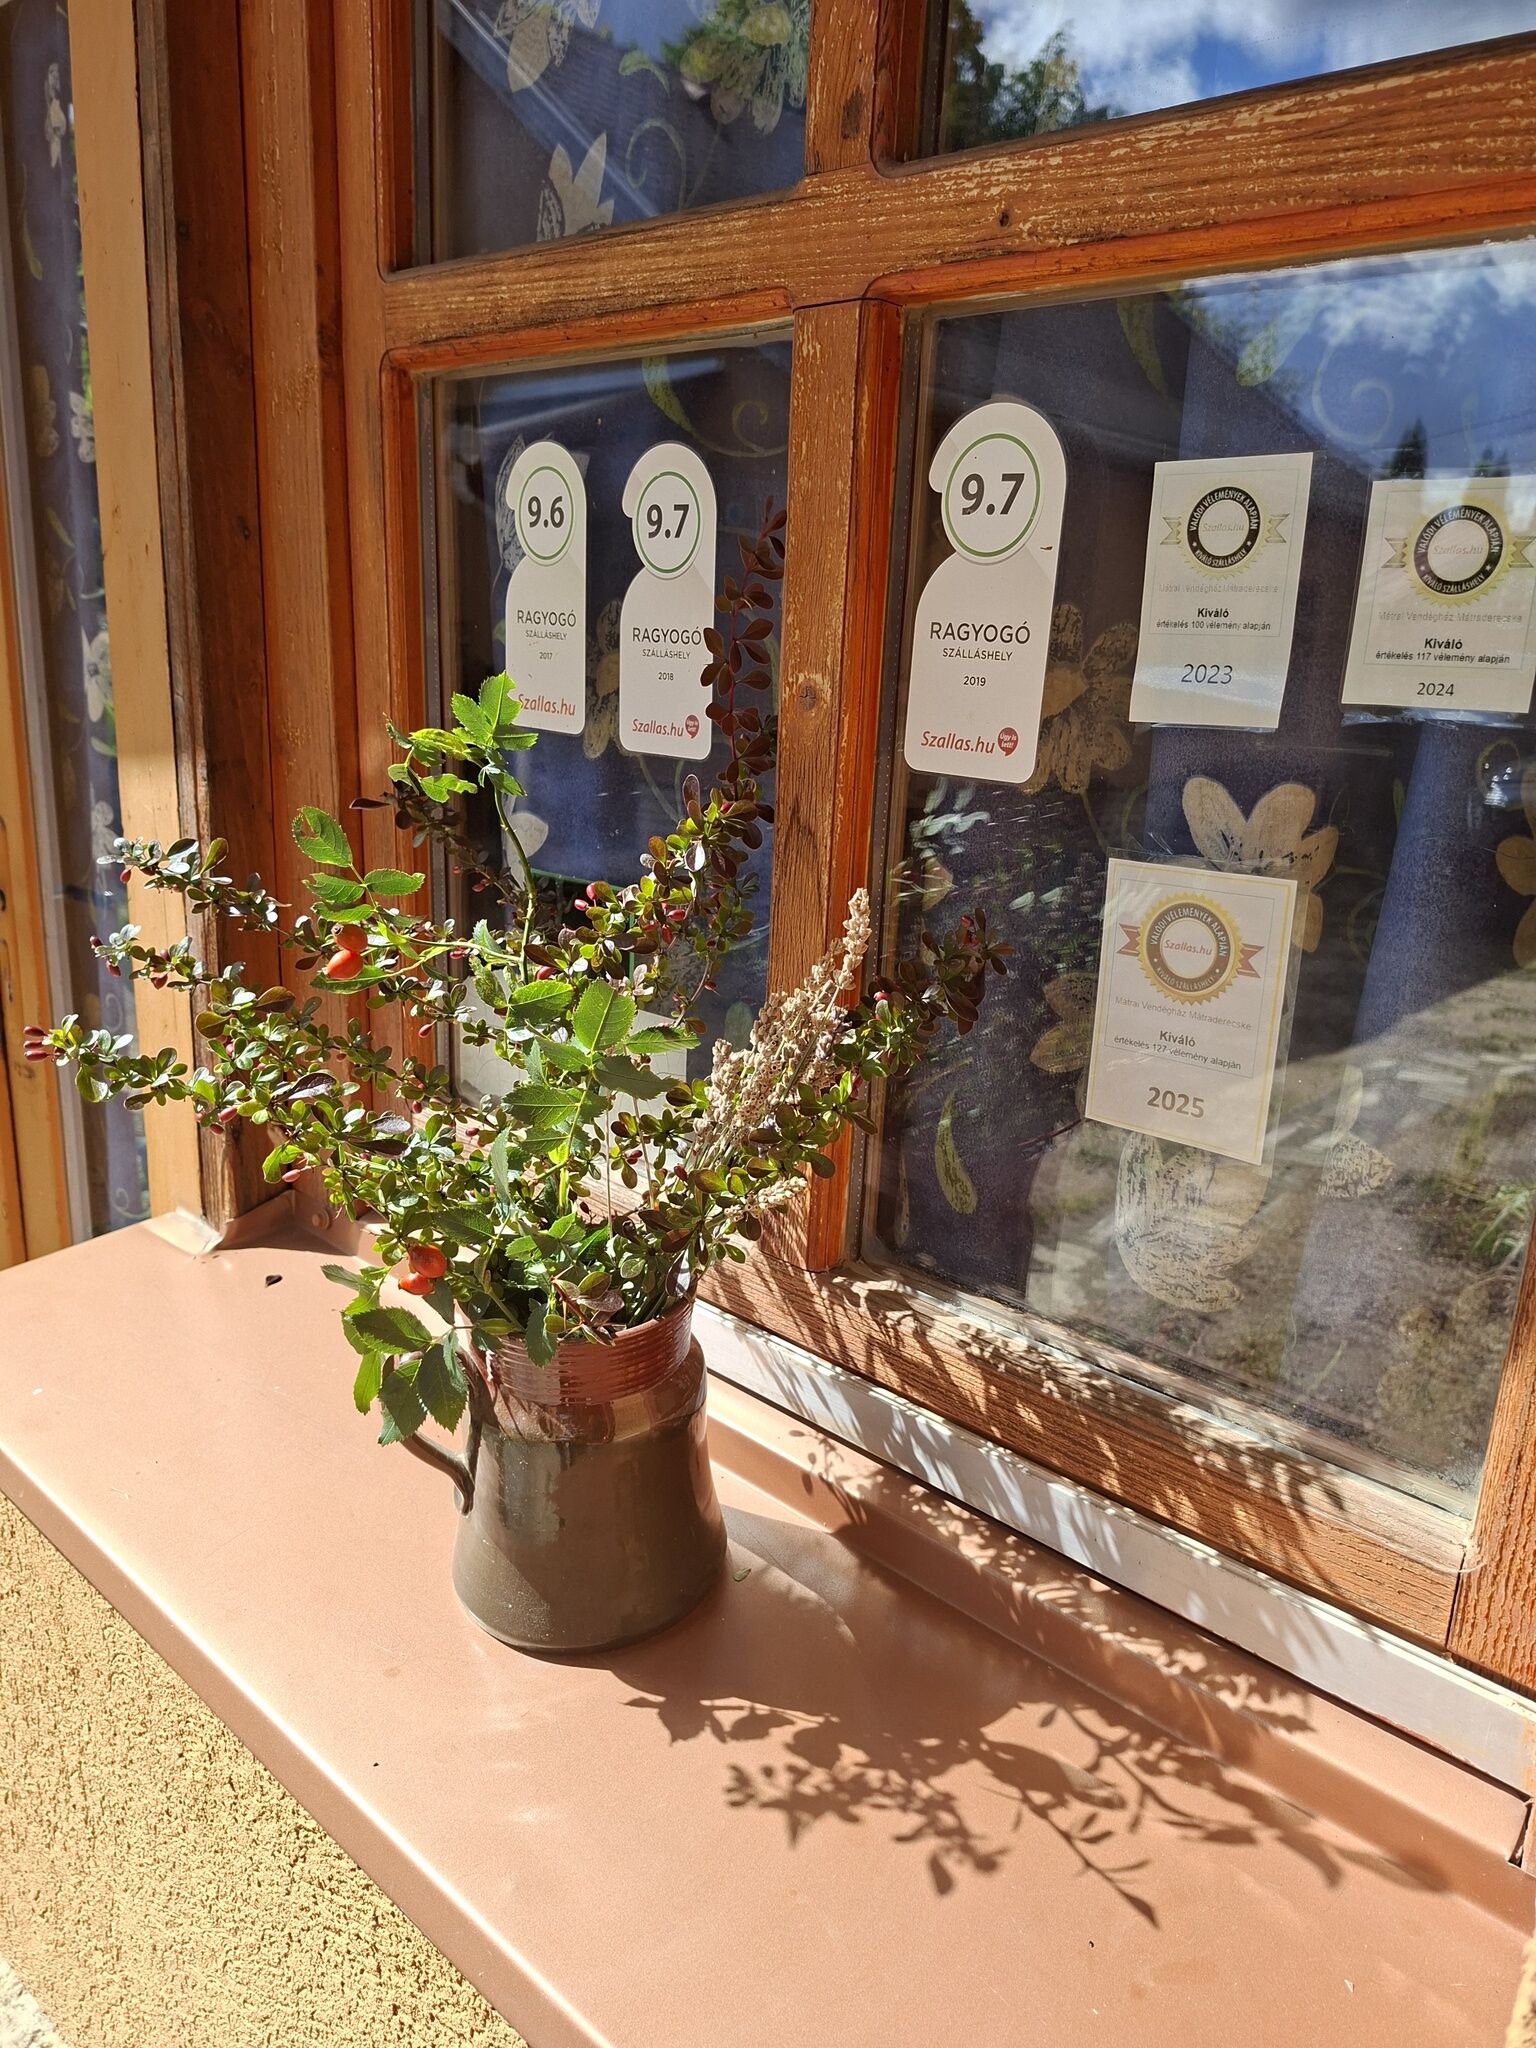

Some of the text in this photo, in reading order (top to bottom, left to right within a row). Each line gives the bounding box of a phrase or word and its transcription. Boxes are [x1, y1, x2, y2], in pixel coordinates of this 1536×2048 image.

[961, 473, 1025, 516] 9.7
[528, 496, 565, 528] 9.6
[1189, 504, 1206, 531] VALÓDI
[1202, 489, 1247, 508] VÉLEMÉNYEK
[646, 504, 690, 539] 9.7
[1417, 525, 1437, 553] VALÓDI
[1434, 508, 1486, 527] VÉLEMÉNYEK
[517, 609, 577, 627] RAGYOGÓ
[1197, 608, 1229, 618] Kiváló
[929, 621, 1031, 645] RAGYOGÓ
[1192, 621, 1205, 629] 100
[1242, 621, 1271, 631] alapján
[525, 630, 568, 641] SZÁLLÁSHELY
[632, 626, 702, 645] RAGYOGÓ
[1424, 638, 1463, 650] Kiváló
[539, 652, 553, 660] 2017
[642, 648, 691, 660] SZÁLLÁSHELY
[942, 648, 1013, 661] SZÁLLÁSHELY
[1375, 651, 1510, 665] értékelés 117 vélemény alapján
[658, 672, 674, 681] 2018
[963, 676, 986, 687] 2019
[1181, 664, 1233, 684] 2023
[1416, 682, 1455, 697] 2024
[518, 694, 576, 716] Szallas.hu
[632, 718, 684, 737] Szallas.hu
[921, 730, 995, 754] Szallas.hu
[1164, 940, 1213, 956] Szallas.hu
[1159, 1030, 1196, 1047] Kiváló
[1114, 1035, 1241, 1070] értékelés 127 vélemény alapján
[1147, 1087, 1205, 1118] 2025
